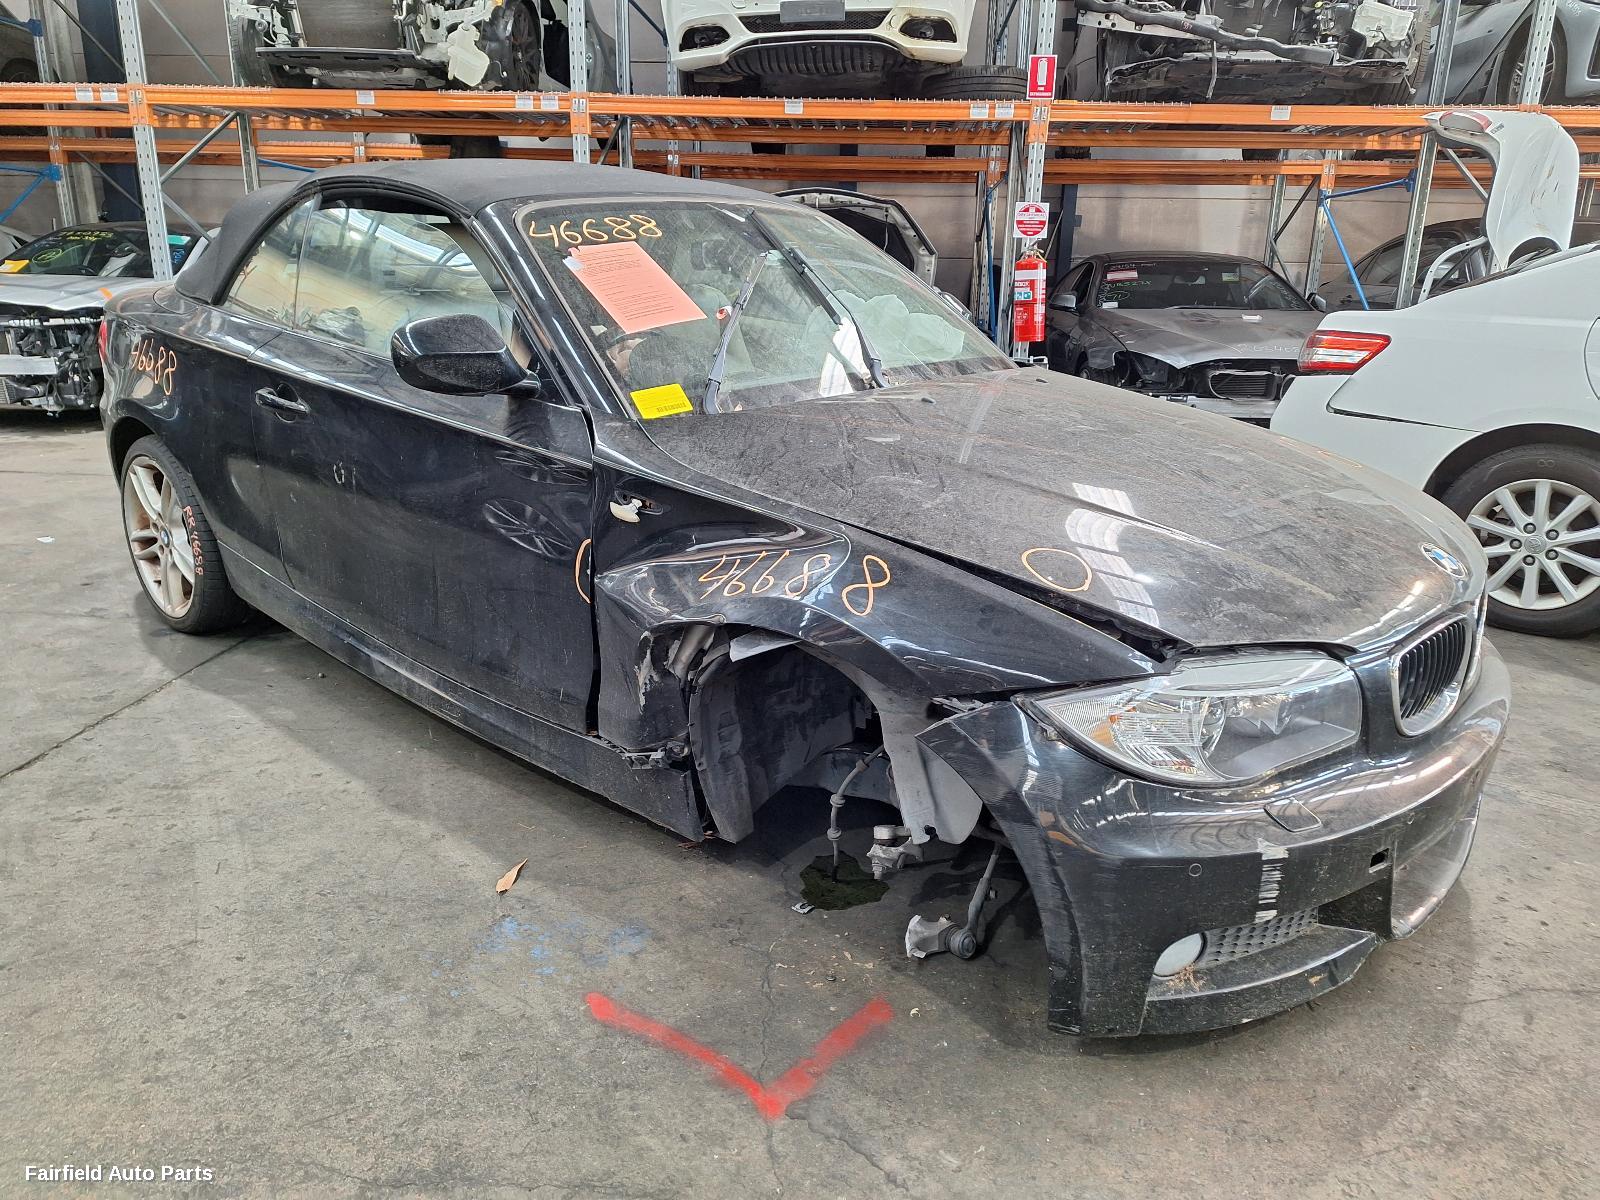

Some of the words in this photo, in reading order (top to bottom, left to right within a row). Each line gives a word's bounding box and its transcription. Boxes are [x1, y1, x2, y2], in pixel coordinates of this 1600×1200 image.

[528, 214, 662, 247] 46688
[130, 338, 177, 395] 46688
[190, 530, 204, 575] 46688
[698, 549, 891, 616] 46688
